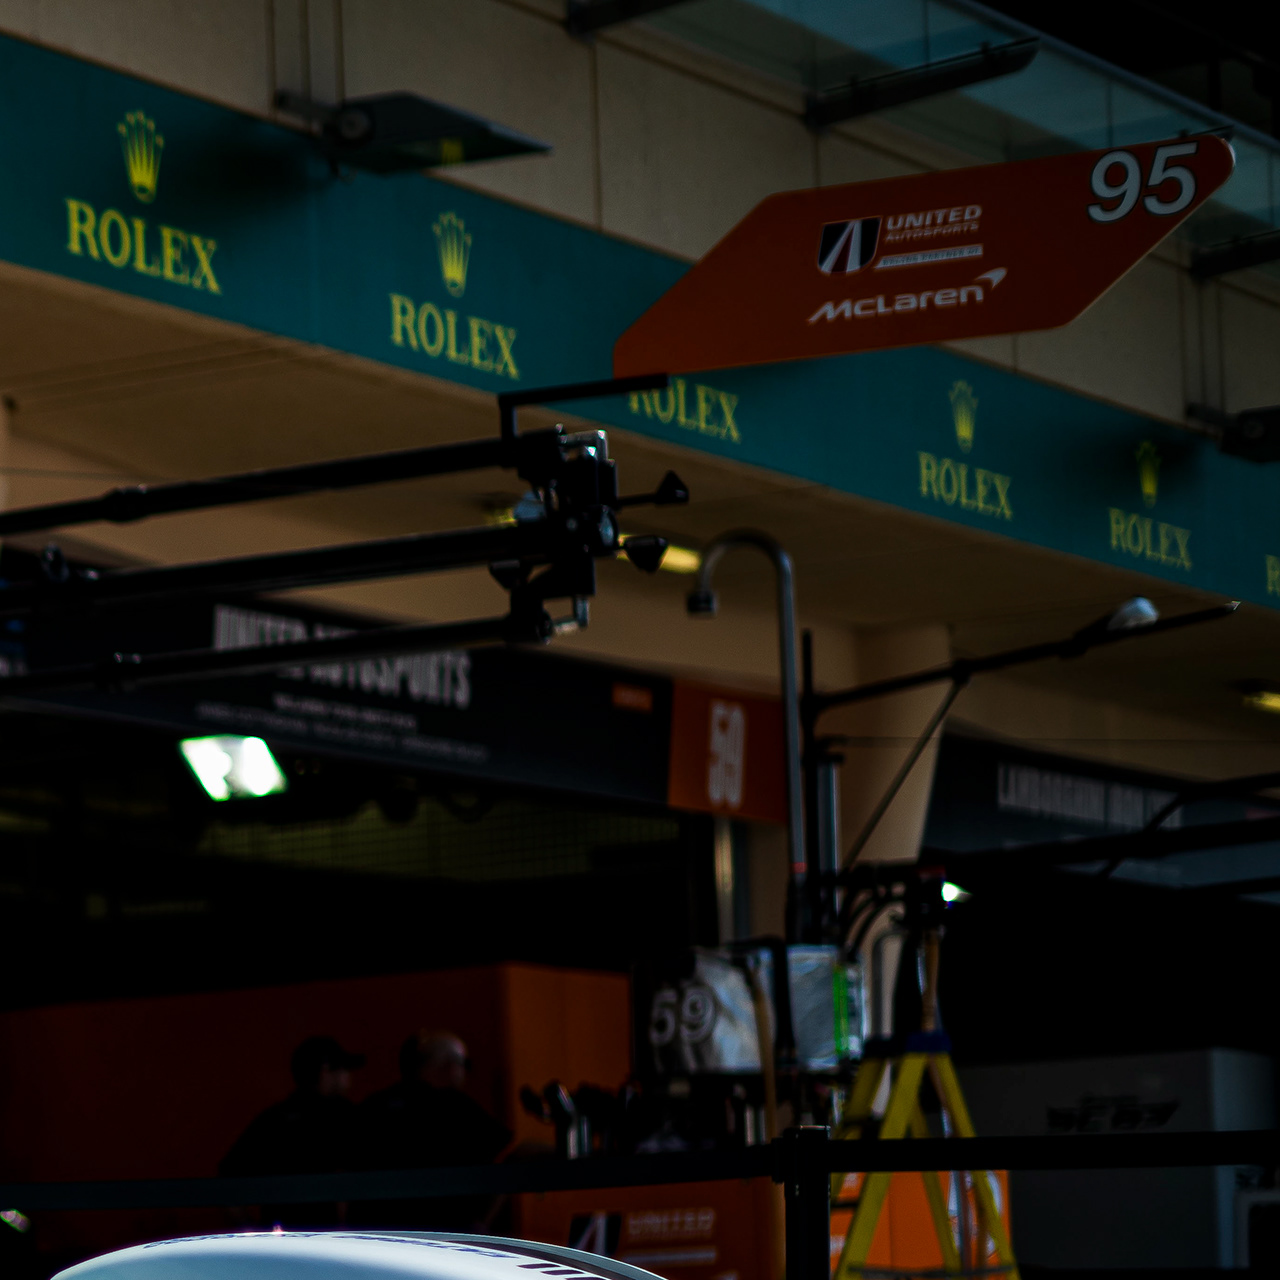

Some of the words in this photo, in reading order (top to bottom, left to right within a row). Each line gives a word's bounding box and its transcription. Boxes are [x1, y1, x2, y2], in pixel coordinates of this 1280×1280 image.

[885, 204, 983, 232] UNITED
[1087, 142, 1199, 222] 95
[65, 198, 222, 295] ROLEX
[389, 293, 520, 381] ROLEX
[806, 285, 984, 325] McLaren
[917, 450, 1014, 523] ROLEX
[1107, 506, 1194, 572] ROLEX
